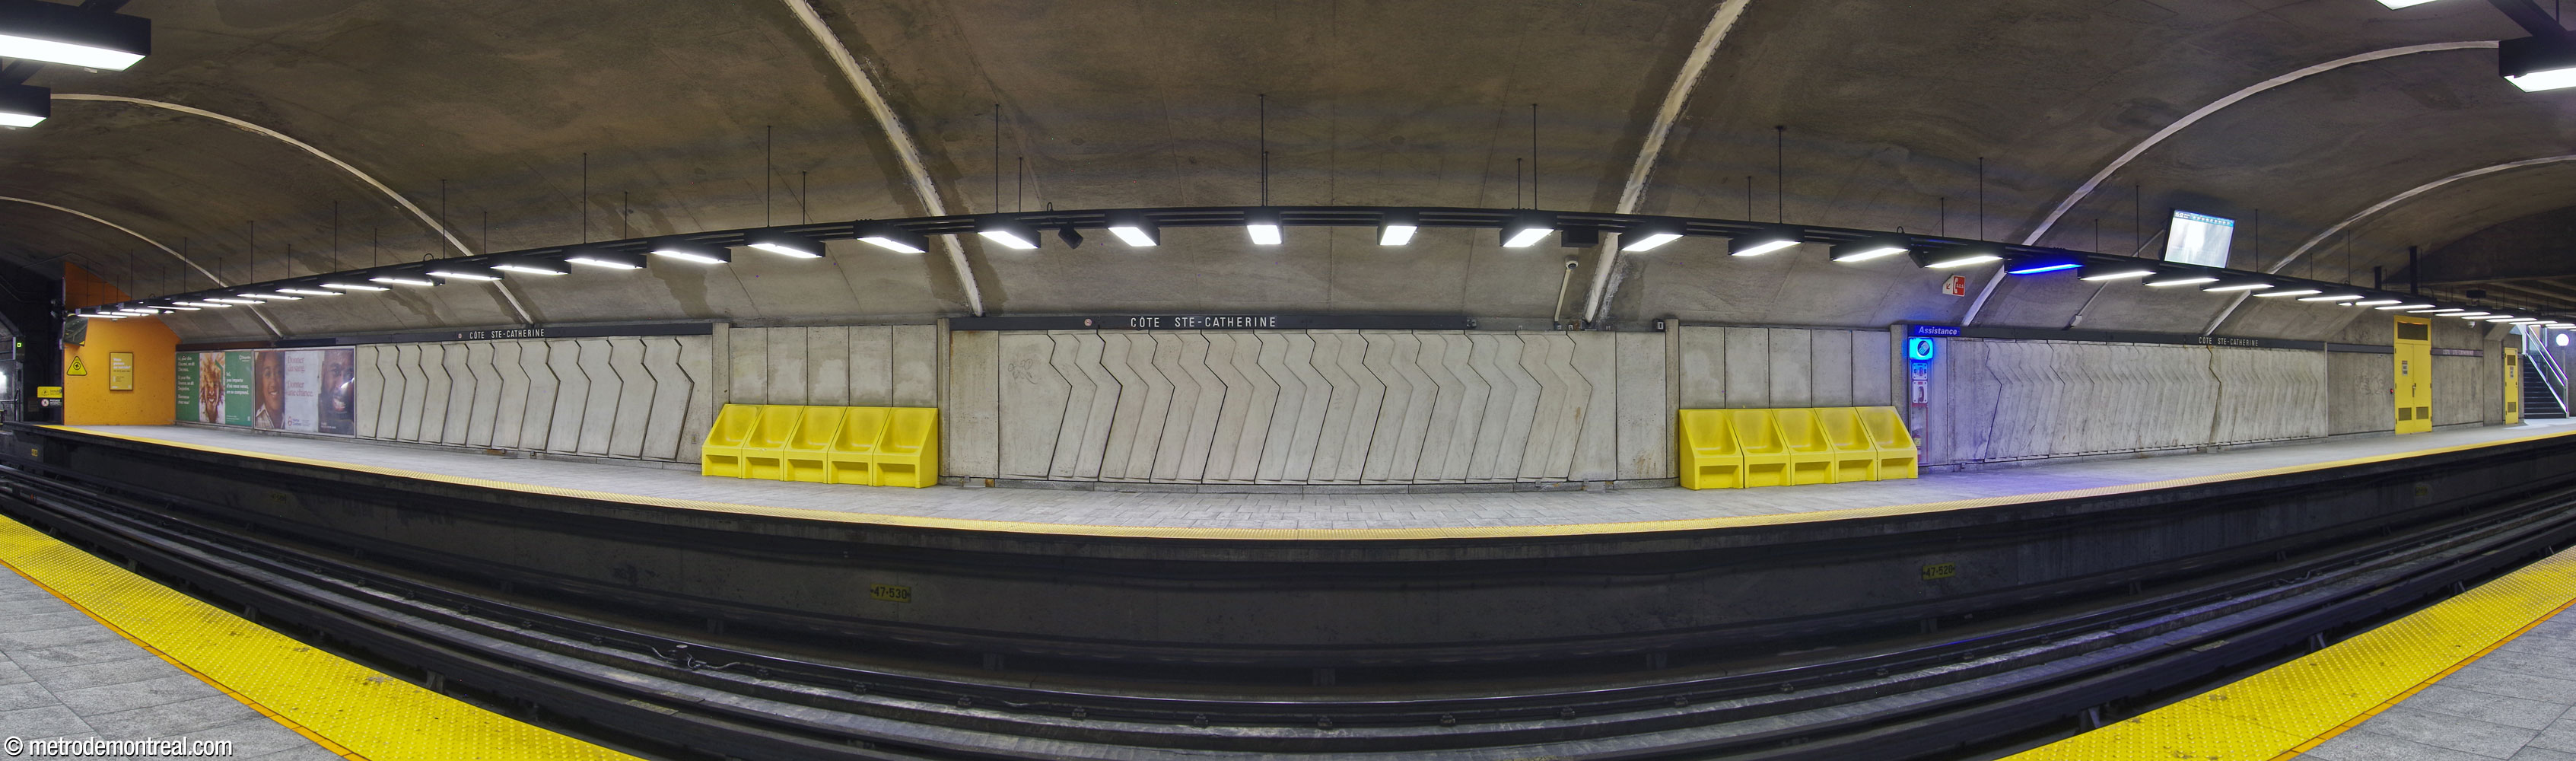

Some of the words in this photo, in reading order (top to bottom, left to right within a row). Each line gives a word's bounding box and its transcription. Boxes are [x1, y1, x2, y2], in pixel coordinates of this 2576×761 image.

[1131, 317, 1160, 328] CÔTE
[1175, 317, 1277, 328] STE-CATHERINE
[469, 330, 485, 339] CÔTE
[491, 328, 545, 339] STE-CATHERINE
[1918, 326, 1957, 335] Assistance
[2217, 337, 2259, 347] STE-CATHERINE
